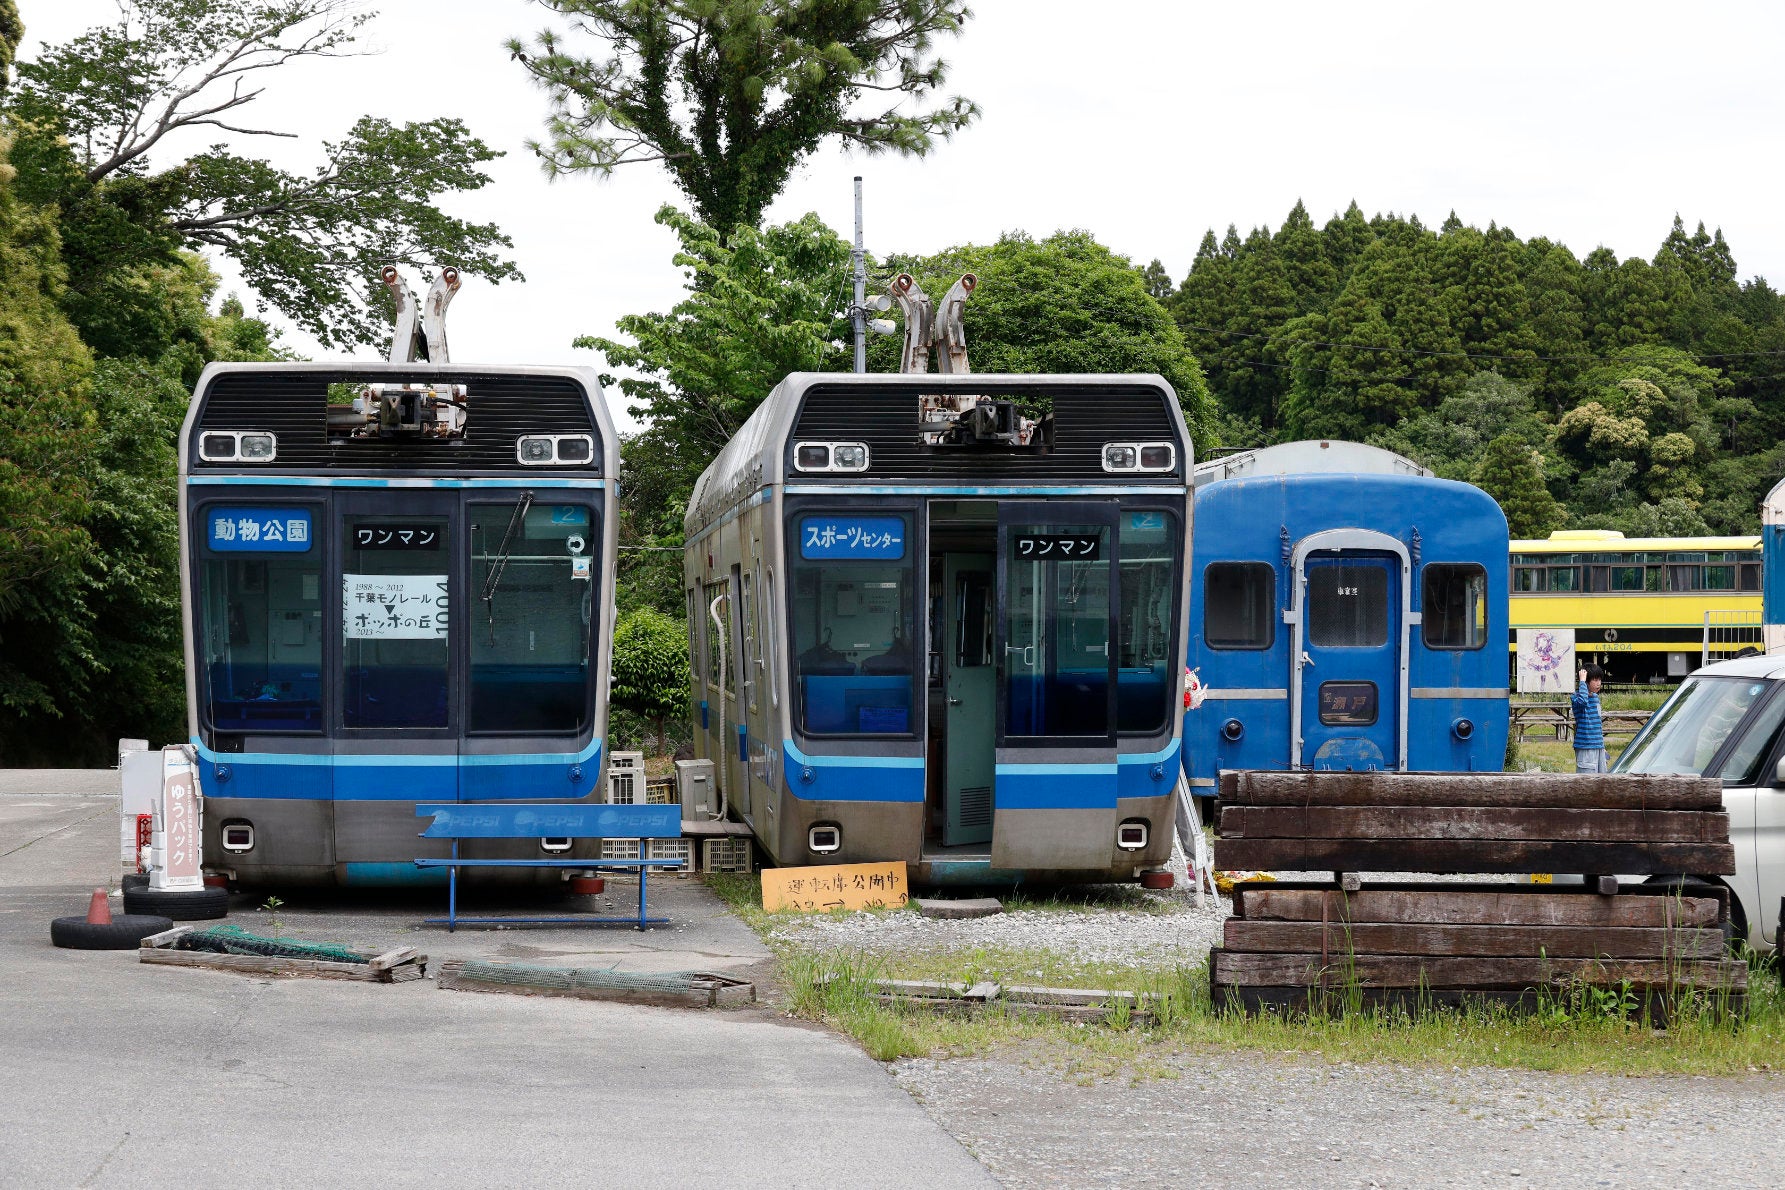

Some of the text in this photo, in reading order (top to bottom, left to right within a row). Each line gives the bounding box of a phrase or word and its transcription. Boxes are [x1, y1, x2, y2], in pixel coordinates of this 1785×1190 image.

[562, 506, 575, 521] 2
[214, 518, 308, 542] 動物公園
[358, 530, 435, 545] ワンマン
[806, 525, 901, 549] スポーツセンター
[1019, 540, 1095, 555] ワンマン
[355, 583, 373, 591] 1988
[386, 584, 404, 592] 2012
[354, 592, 432, 604] 千葉モノレール
[435, 582, 449, 635] 1004
[354, 612, 432, 629] ポッポの丘
[355, 628, 374, 636] 2013
[171, 784, 186, 866] ゆうパック
[451, 815, 667, 827] PEPSI PEPSI PEPSI
